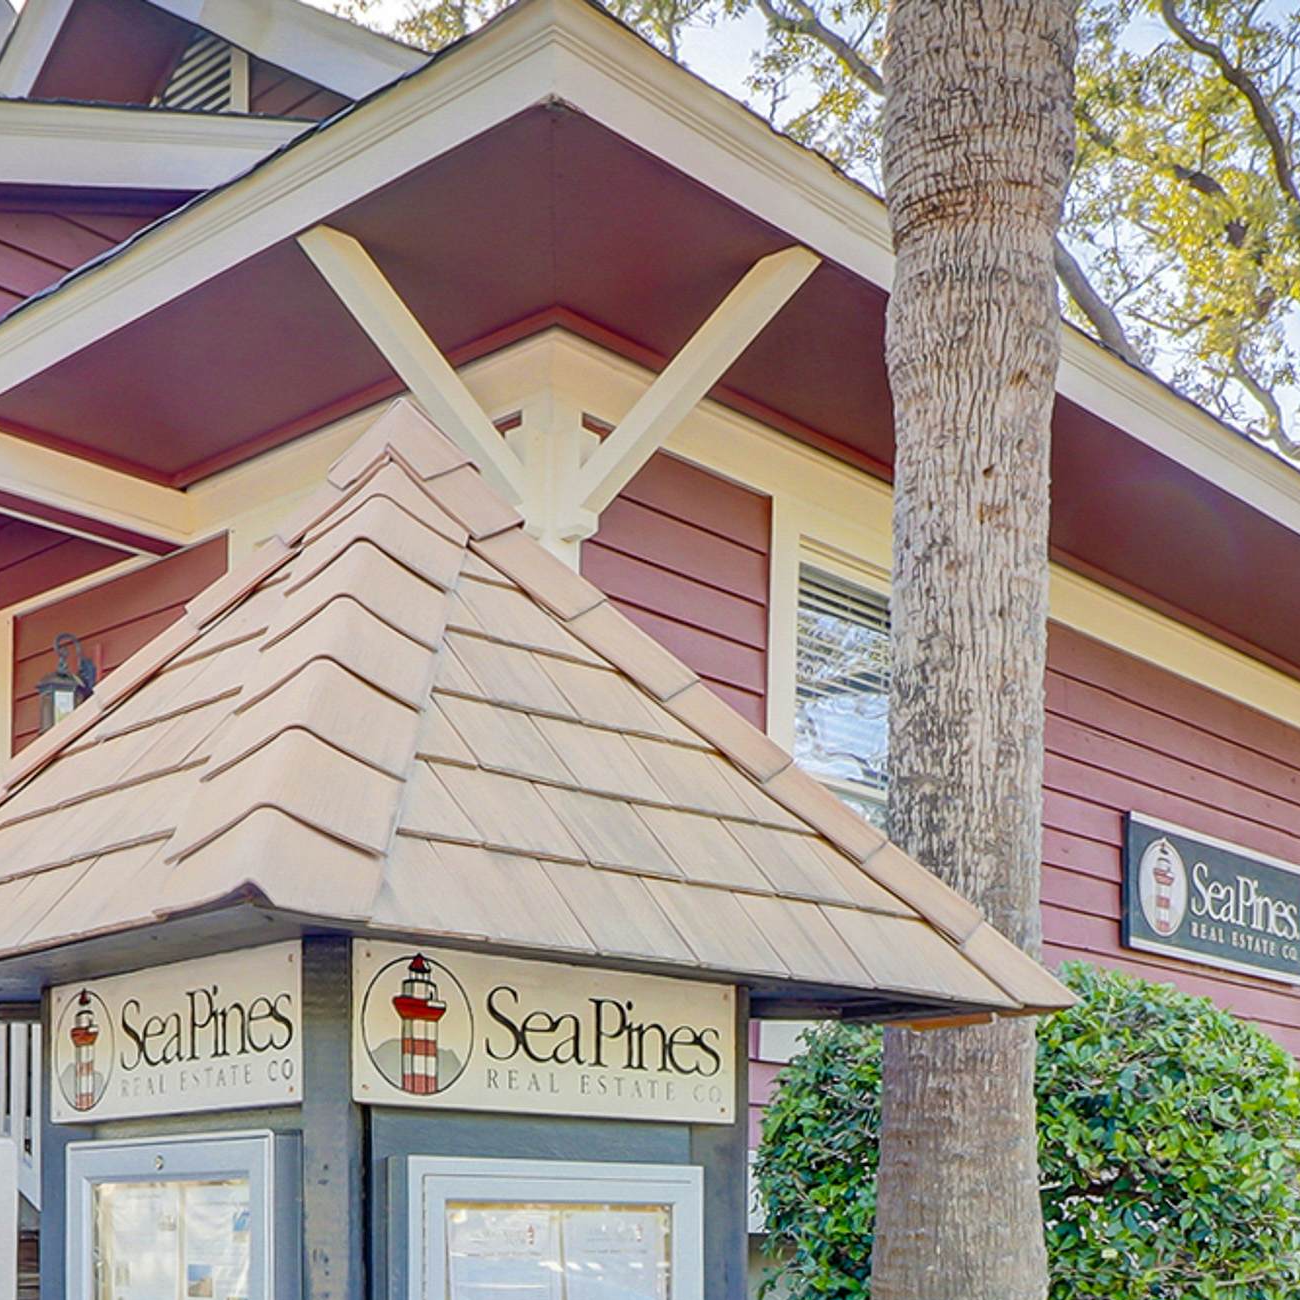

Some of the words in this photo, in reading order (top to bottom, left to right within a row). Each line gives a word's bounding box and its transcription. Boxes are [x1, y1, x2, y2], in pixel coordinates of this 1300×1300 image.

[1191, 921, 1225, 944] REAL
[1232, 932, 1276, 957] ESTATE
[121, 1078, 167, 1097] REAL
[180, 1064, 252, 1090] ESTATE
[267, 1058, 294, 1082] CO
[486, 1068, 560, 1094] REAL
[580, 1073, 676, 1101] ESTATE
[693, 1083, 723, 1104] CO
